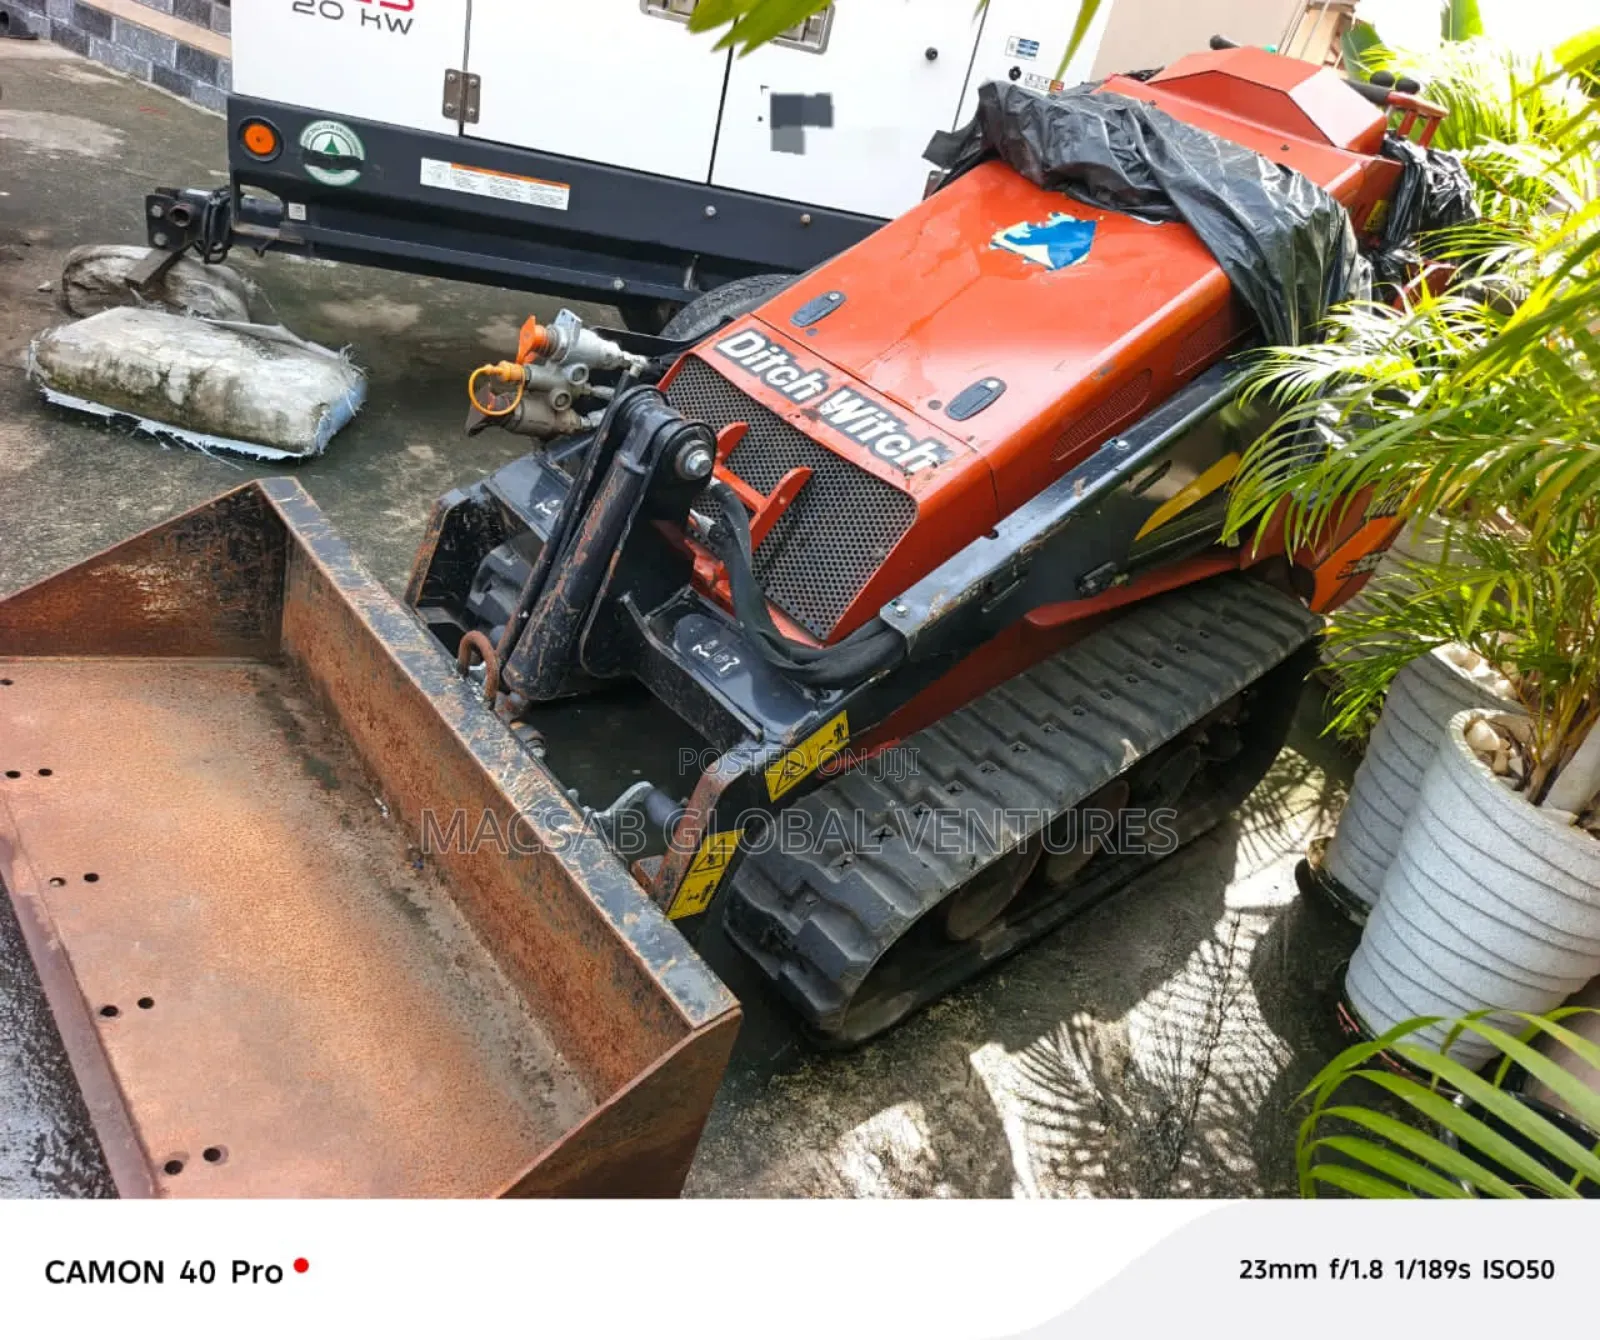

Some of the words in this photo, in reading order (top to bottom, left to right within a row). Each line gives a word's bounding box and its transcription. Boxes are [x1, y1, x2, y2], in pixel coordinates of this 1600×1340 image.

[292, 0, 344, 20] 20
[714, 329, 828, 404] Ditch
[817, 387, 945, 474] Witch
